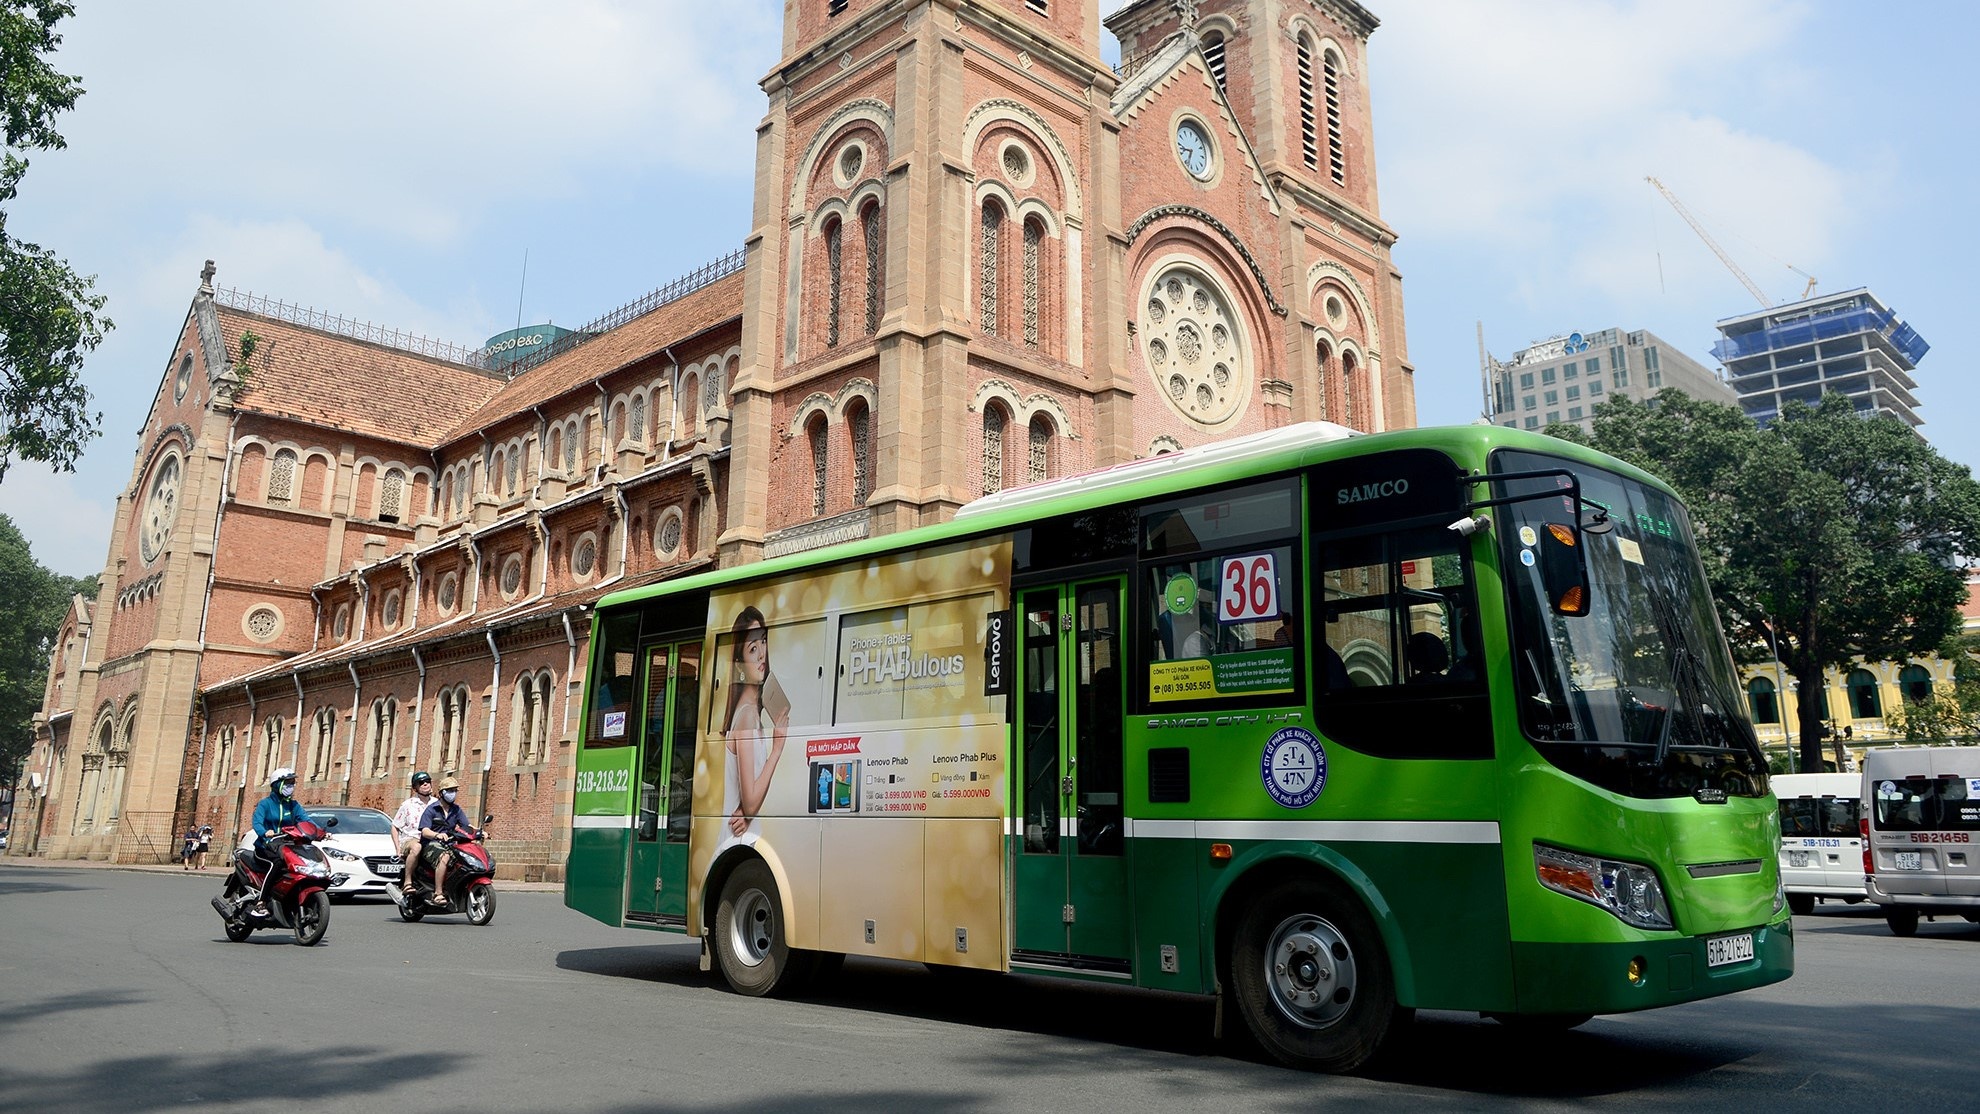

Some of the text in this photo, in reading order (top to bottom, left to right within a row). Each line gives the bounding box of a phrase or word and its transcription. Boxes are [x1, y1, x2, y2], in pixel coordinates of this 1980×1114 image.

[1337, 478, 1409, 505] SAMCO
[1225, 557, 1271, 618] 36
[990, 618, 1002, 689] Lenovo
[848, 645, 964, 686] PHABulous
[1161, 681, 1211, 695] (08) 39.505.505
[1147, 717, 1209, 729] SAMCO
[1216, 715, 1259, 726] CITY
[866, 756, 909, 767] Lenovo Phab
[932, 752, 997, 764] Lenovo Phab Plus
[576, 769, 629, 792] 51B-218.22
[1282, 772, 1306, 786] 47N
[1802, 839, 1841, 847] 51B-176.31
